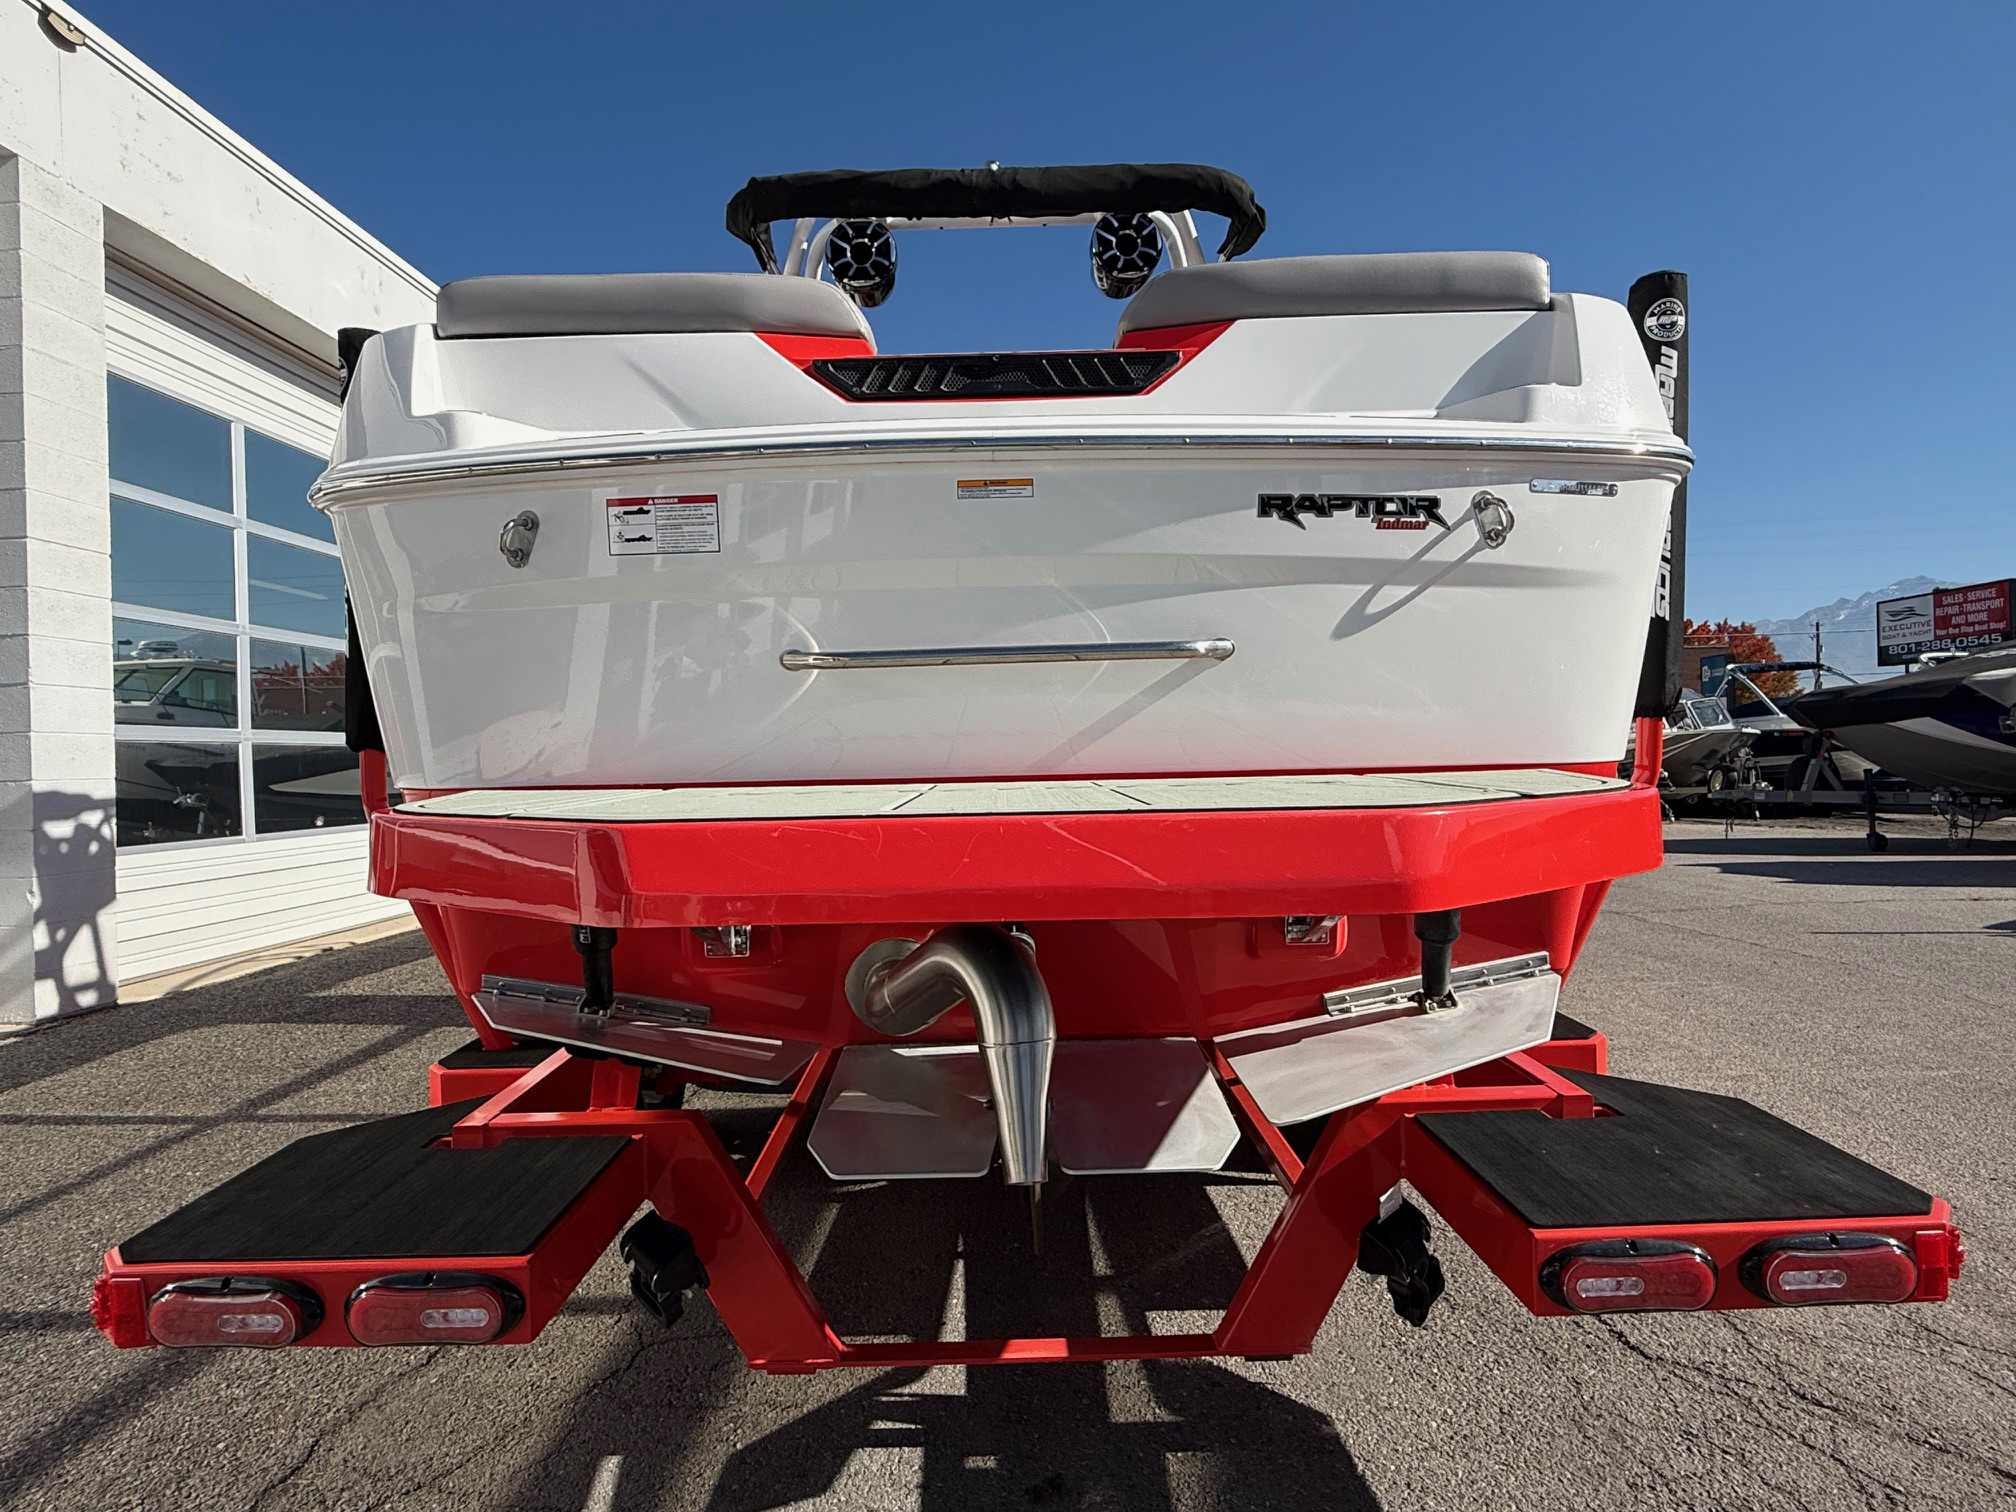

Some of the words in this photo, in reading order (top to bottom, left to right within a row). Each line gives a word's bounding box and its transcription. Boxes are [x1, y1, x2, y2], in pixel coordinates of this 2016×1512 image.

[1653, 301, 1682, 314] MARINE
[1258, 494, 1450, 530] RAPTOR
[1375, 517, 1430, 530] Indmar
[1942, 593, 1964, 605] SALES
[1966, 587, 1997, 601] SERVICE
[1935, 605, 1960, 617] REPAIR
[1962, 598, 2005, 613] TRANSPORT
[1951, 614, 1966, 625] AND
[1967, 612, 1989, 623] MORE
[1882, 619, 1932, 633] EXECUTIVE
[1960, 625, 1974, 633] Stop
[1974, 623, 1989, 631] Boat
[1908, 629, 1933, 637] YACHT
